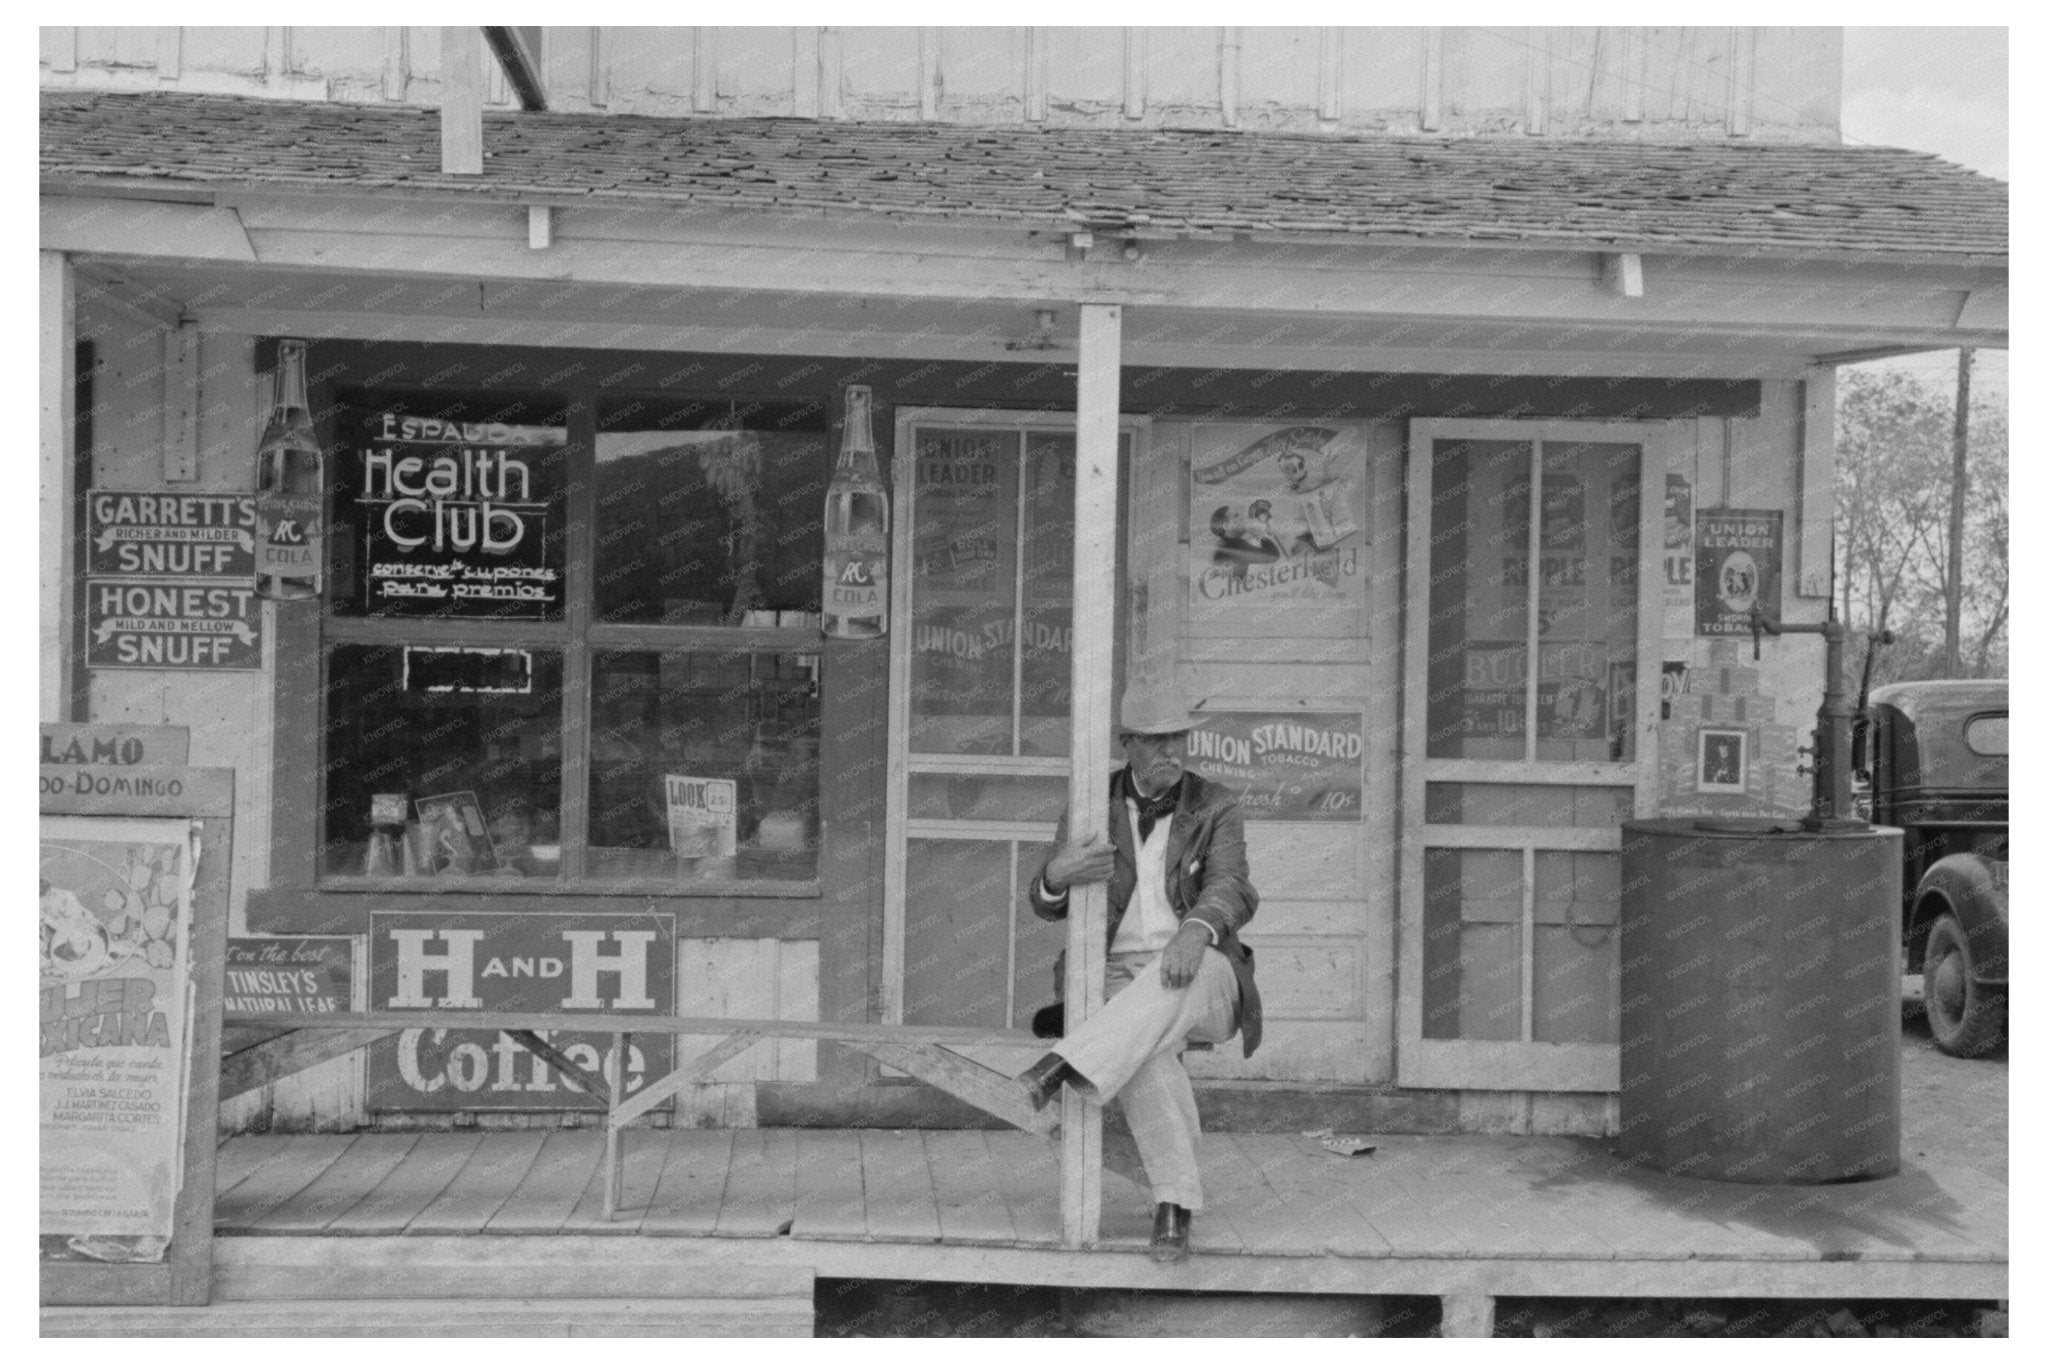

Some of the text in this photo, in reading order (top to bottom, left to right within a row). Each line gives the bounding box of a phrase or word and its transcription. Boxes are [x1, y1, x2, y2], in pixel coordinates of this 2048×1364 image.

[923, 438, 991, 460] UNION
[364, 448, 529, 499] Health
[918, 463, 997, 484] LEADER
[95, 496, 256, 526] GARRETT'S
[383, 498, 525, 549] Club
[115, 528, 239, 541] RICHER AND MILDER
[1709, 523, 1769, 535] UNION
[1704, 537, 1774, 549] LEADER
[119, 544, 235, 572] SNUFF
[265, 548, 313, 564] COLA
[1198, 547, 1358, 601] Chesterfield
[100, 587, 254, 617] HONEST
[452, 582, 546, 600] premios
[832, 588, 879, 604] COLA
[116, 620, 234, 632] MILD AND MELLOW
[1702, 622, 1752, 632] TOBAC
[1717, 613, 1752, 622] SMOKIN
[117, 635, 233, 664] SNUFF
[916, 619, 1073, 660] UNION STANDAR
[41, 735, 144, 765] LAMO
[1187, 724, 1362, 765] UNION STANDARD
[1199, 753, 1320, 779] CHEWING TOBACCO
[669, 781, 706, 808] LOOK
[1238, 782, 1285, 809] fresh
[258, 941, 288, 962] the
[291, 939, 332, 963] best
[226, 968, 318, 994] TINSLEY'S
[388, 929, 656, 1009] H AND H
[67, 1088, 152, 1099] ELVIA SALCEDO
[71, 1100, 116, 1110] MARTINEZ
[118, 1101, 161, 1112] CASADO
[53, 1111, 161, 1124] MARGARITA CORTES
